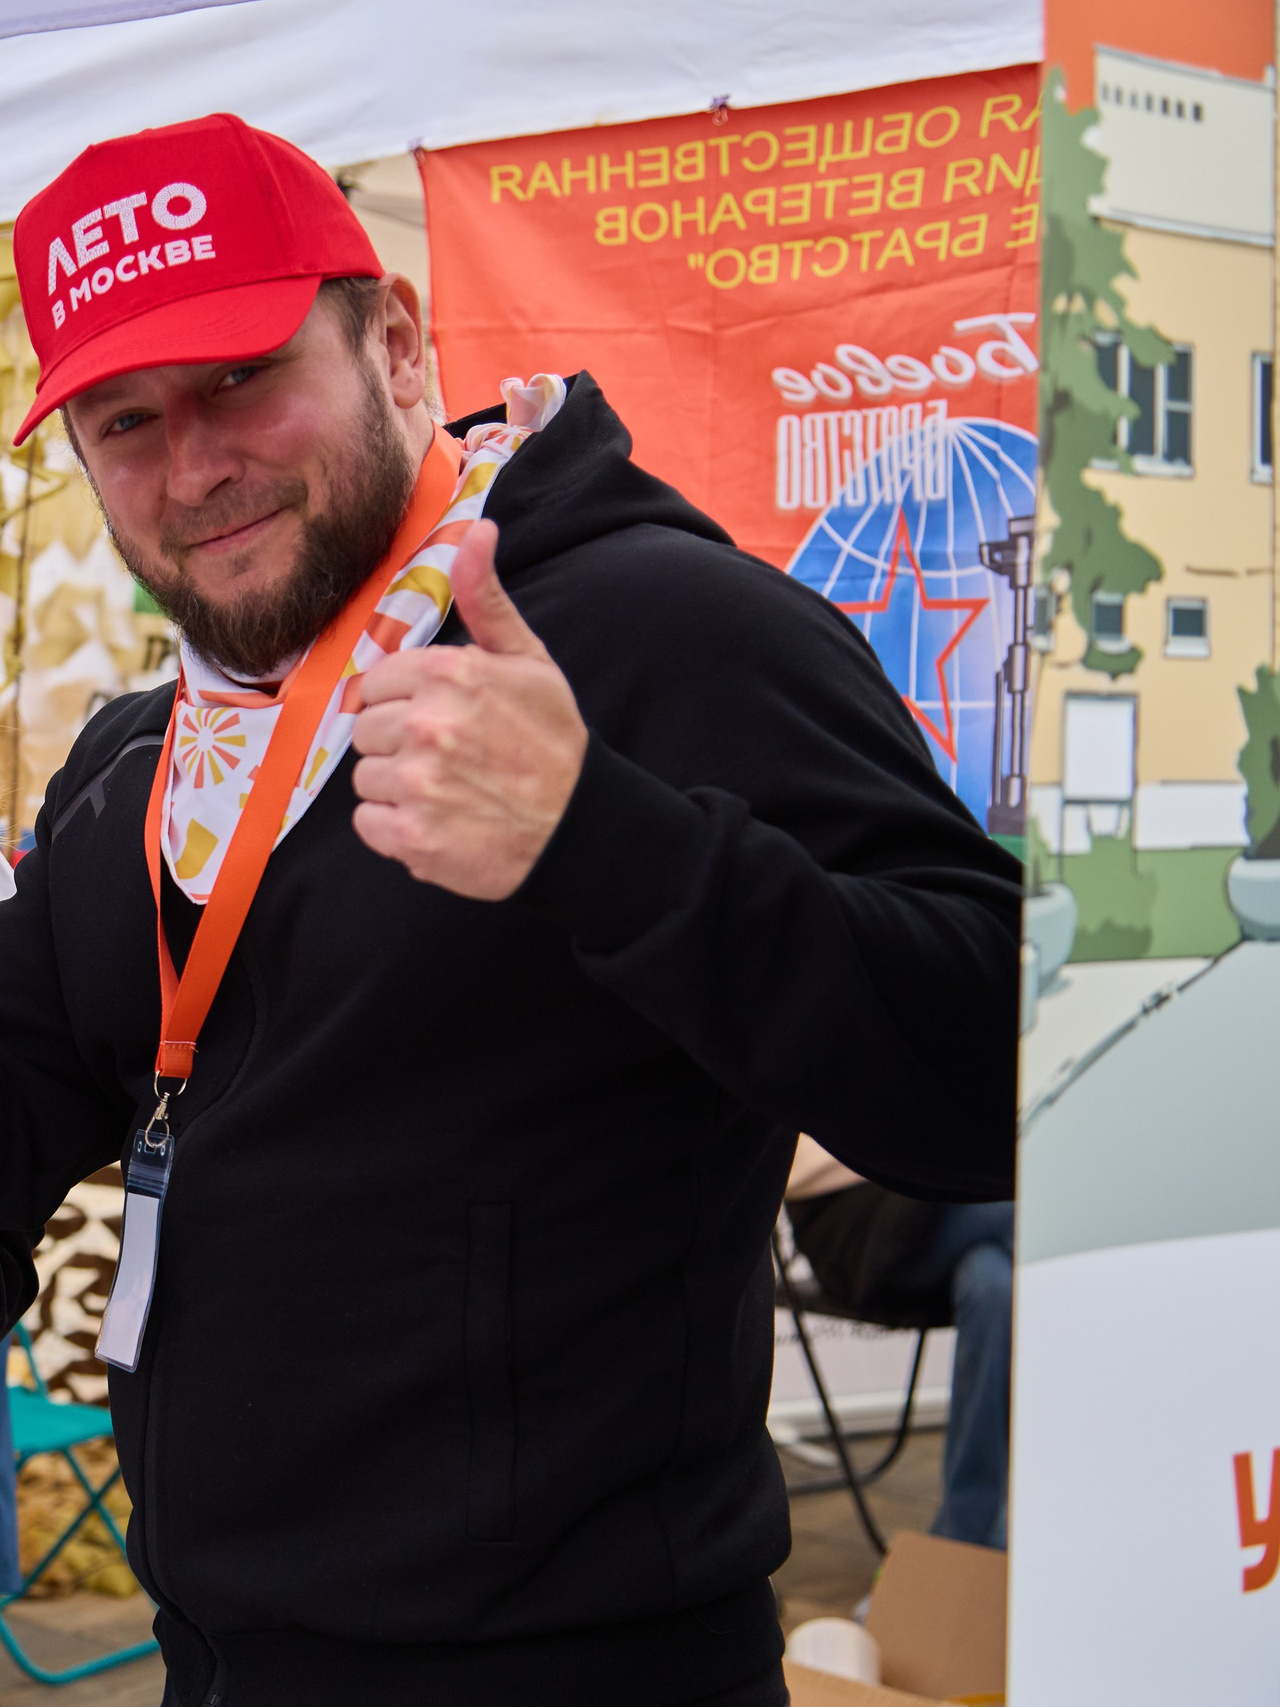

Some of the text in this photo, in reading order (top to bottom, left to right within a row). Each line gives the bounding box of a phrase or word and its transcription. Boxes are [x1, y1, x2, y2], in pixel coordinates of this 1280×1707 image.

[48, 182, 207, 297] ЛЕТО
[51, 234, 216, 331] В МОСКВЕ
